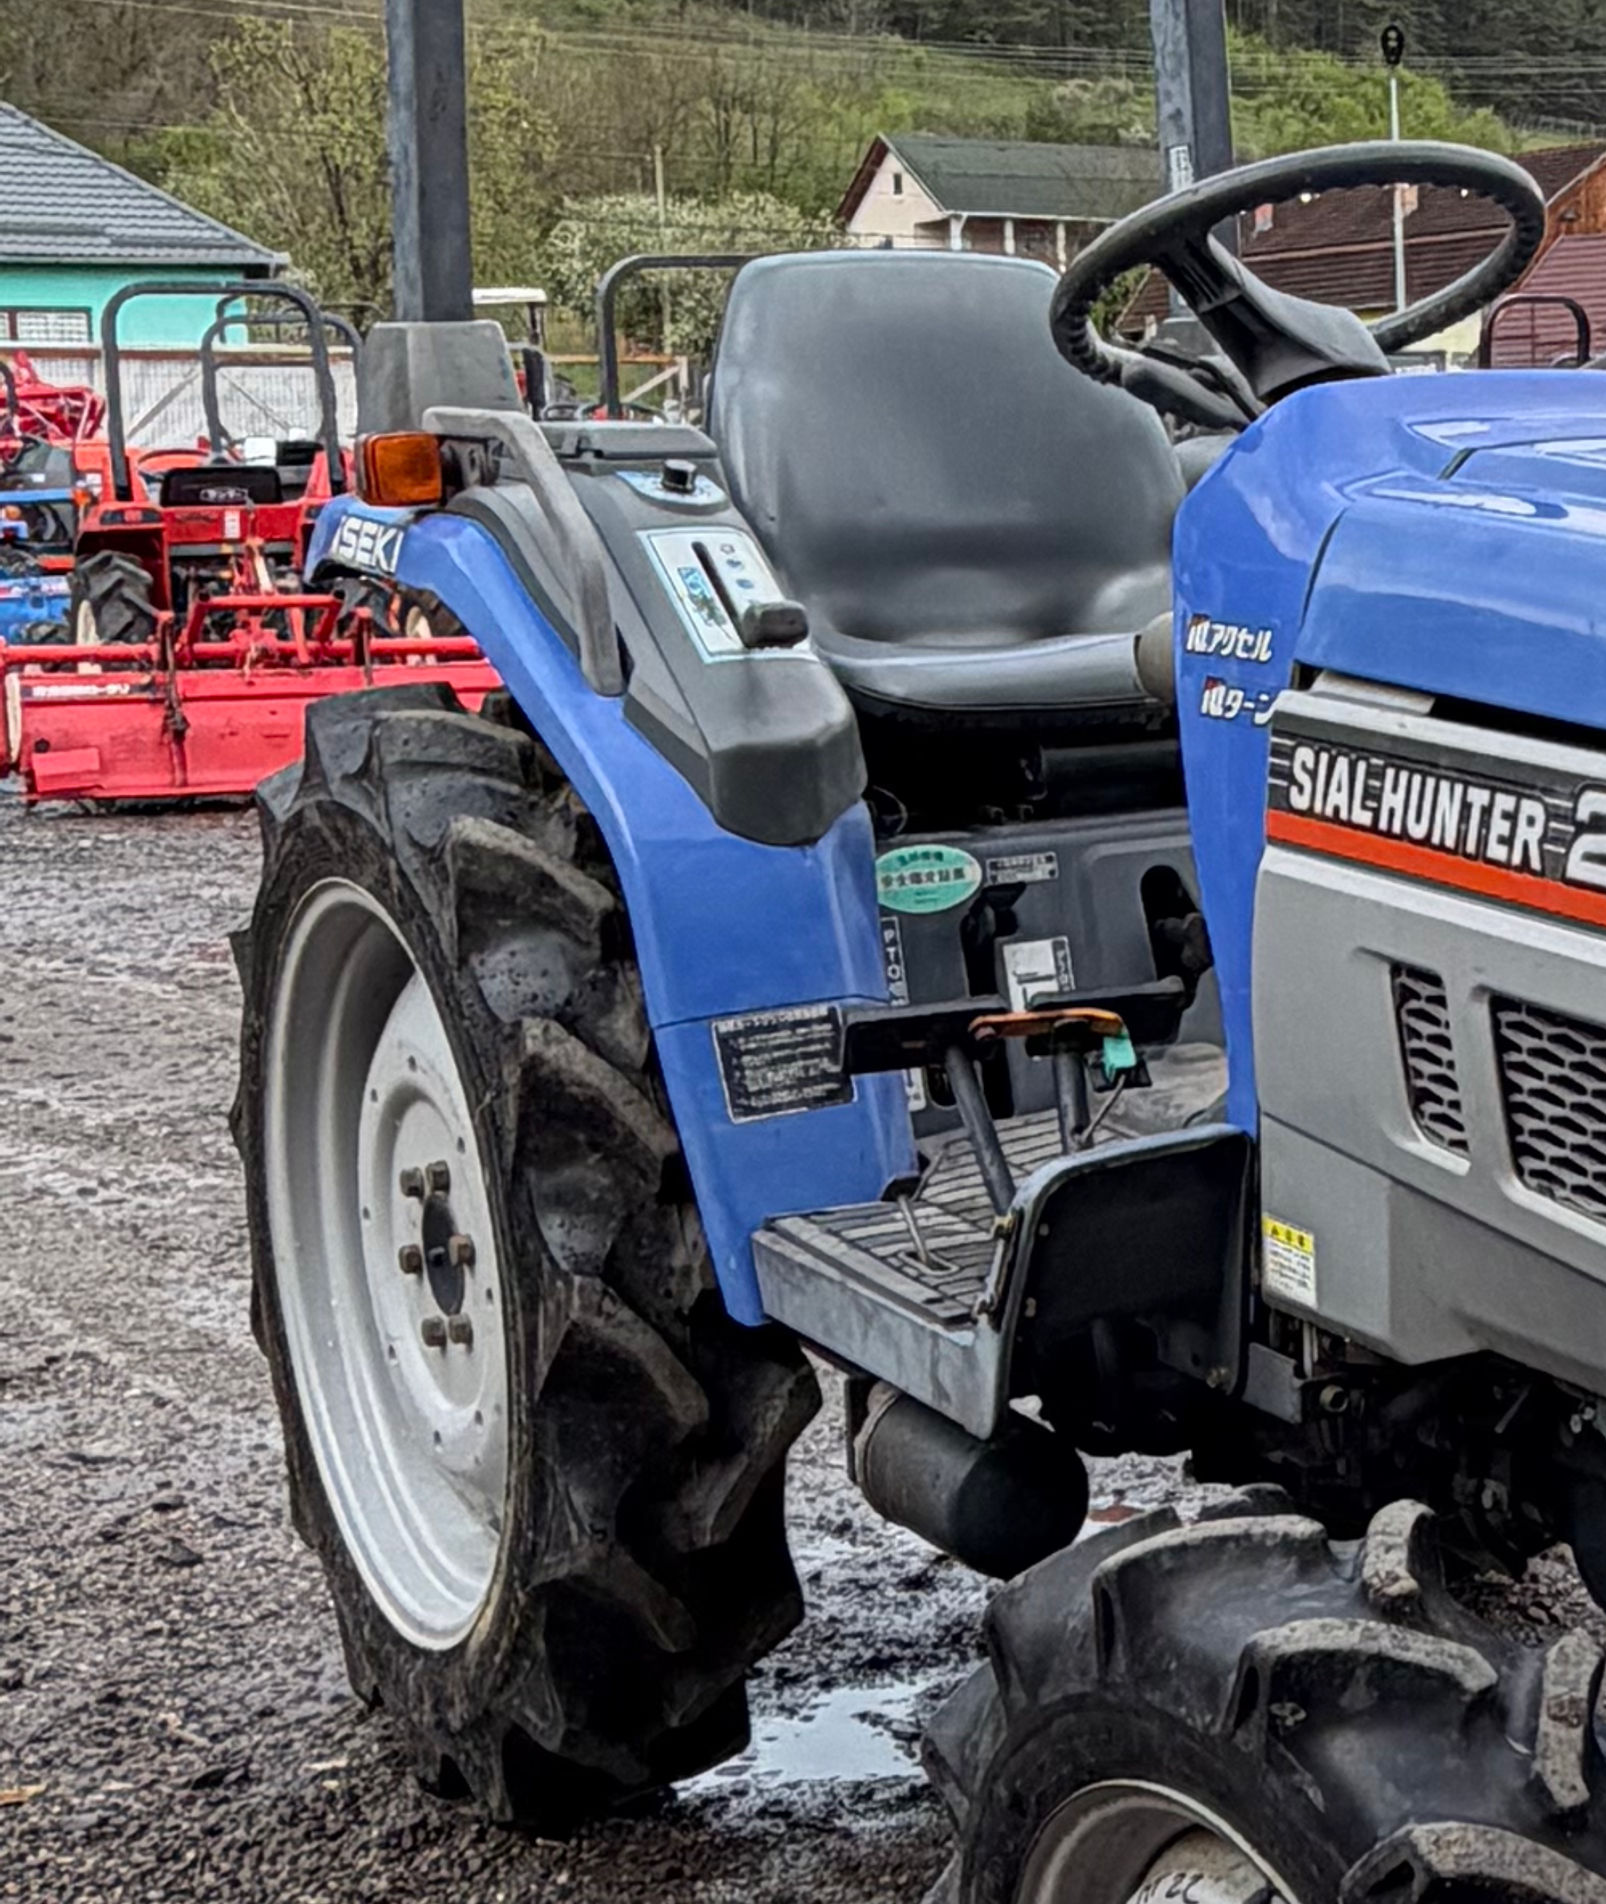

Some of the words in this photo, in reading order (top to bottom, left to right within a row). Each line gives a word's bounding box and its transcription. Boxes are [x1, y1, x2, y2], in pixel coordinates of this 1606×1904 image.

[329, 515, 404, 573] ISEKI
[1289, 746, 1373, 826] SIAL
[1378, 766, 1547, 872] HUNTER
